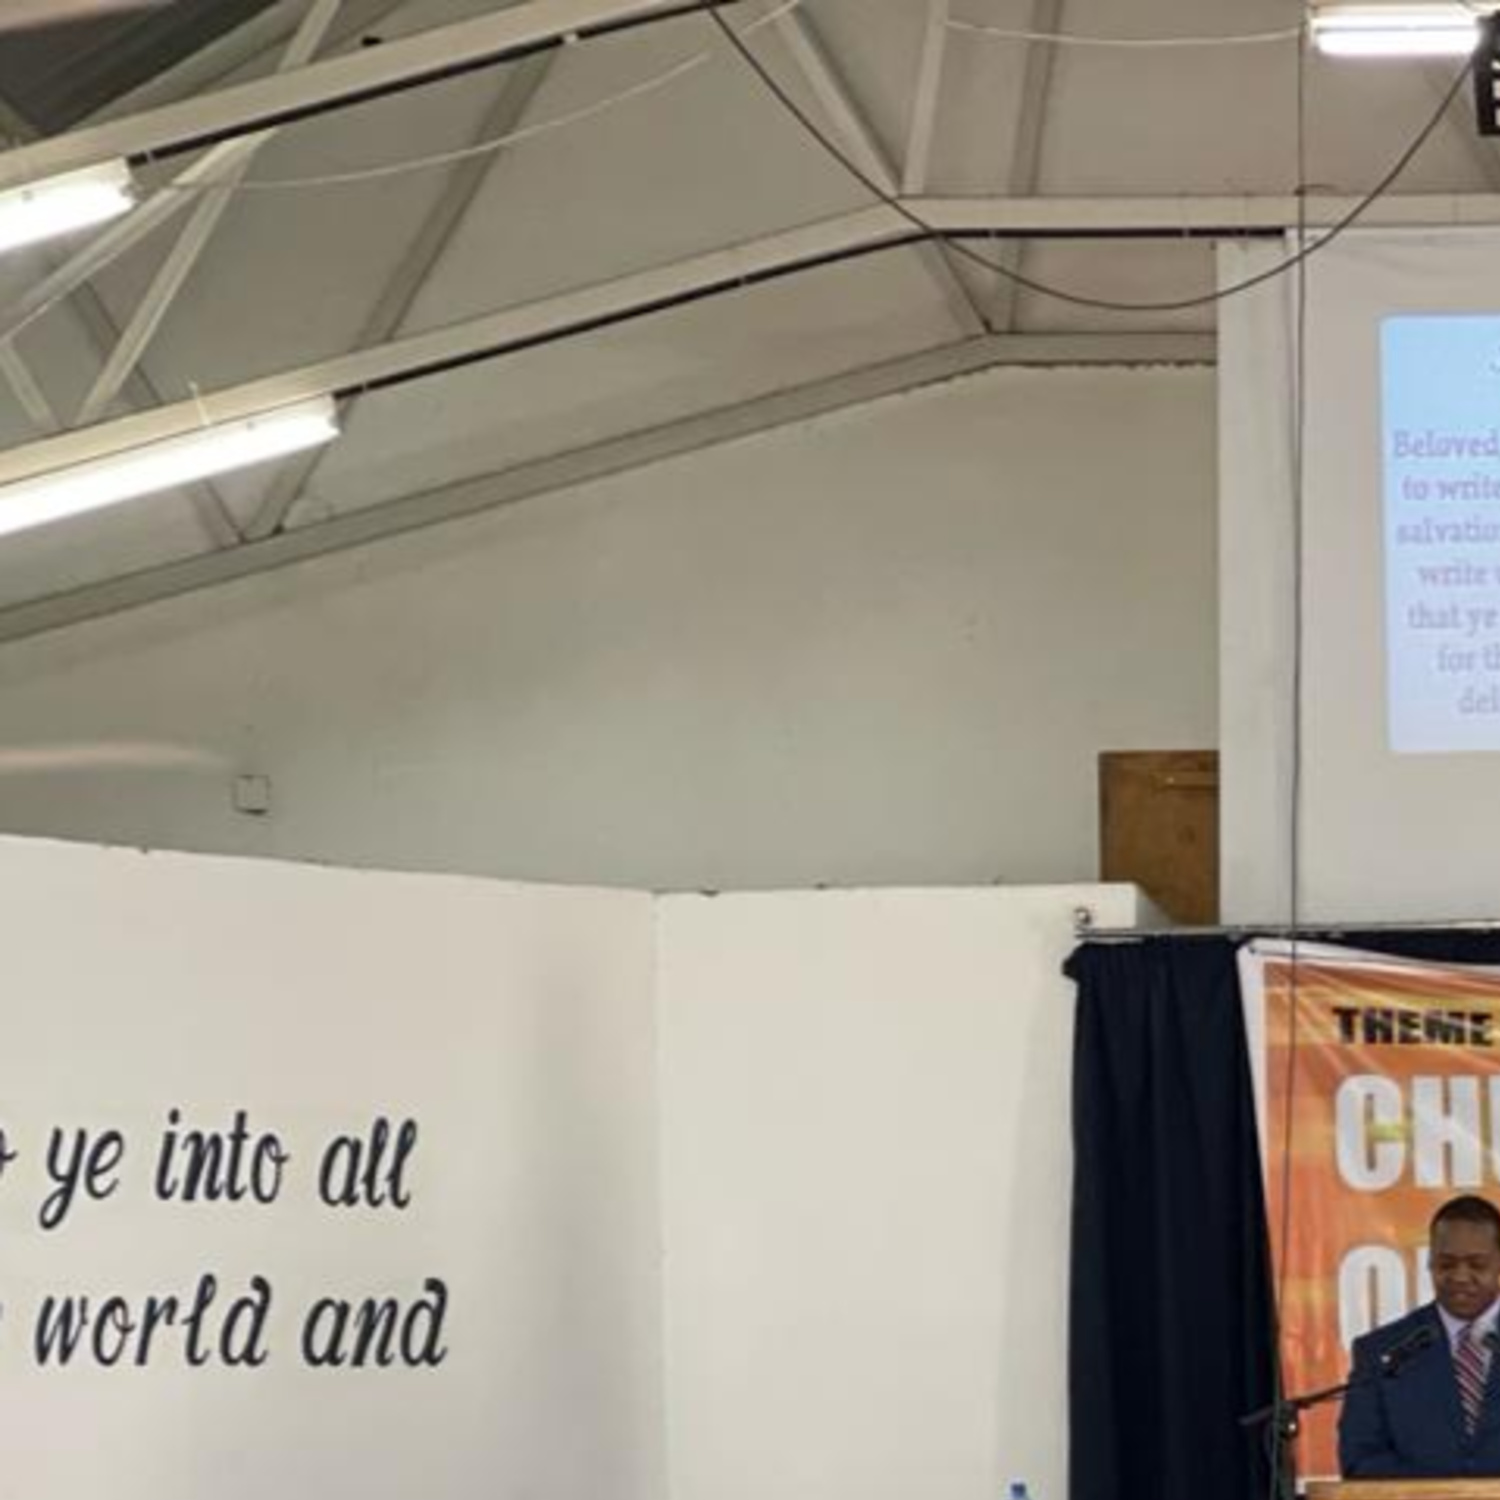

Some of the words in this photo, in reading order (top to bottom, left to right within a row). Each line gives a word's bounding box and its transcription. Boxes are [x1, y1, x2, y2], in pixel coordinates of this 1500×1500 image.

[1402, 475, 1429, 501] to
[1418, 557, 1488, 588] write
[1407, 601, 1461, 630] that
[1465, 608, 1499, 638] ye
[1437, 642, 1476, 673] for
[1332, 1007, 1493, 1047] THEME
[38, 1125, 125, 1230] ye
[154, 1107, 290, 1204] into
[317, 1116, 418, 1210] all
[1338, 1242, 1440, 1358] O
[34, 1273, 272, 1367] world
[301, 1277, 449, 1367] and
